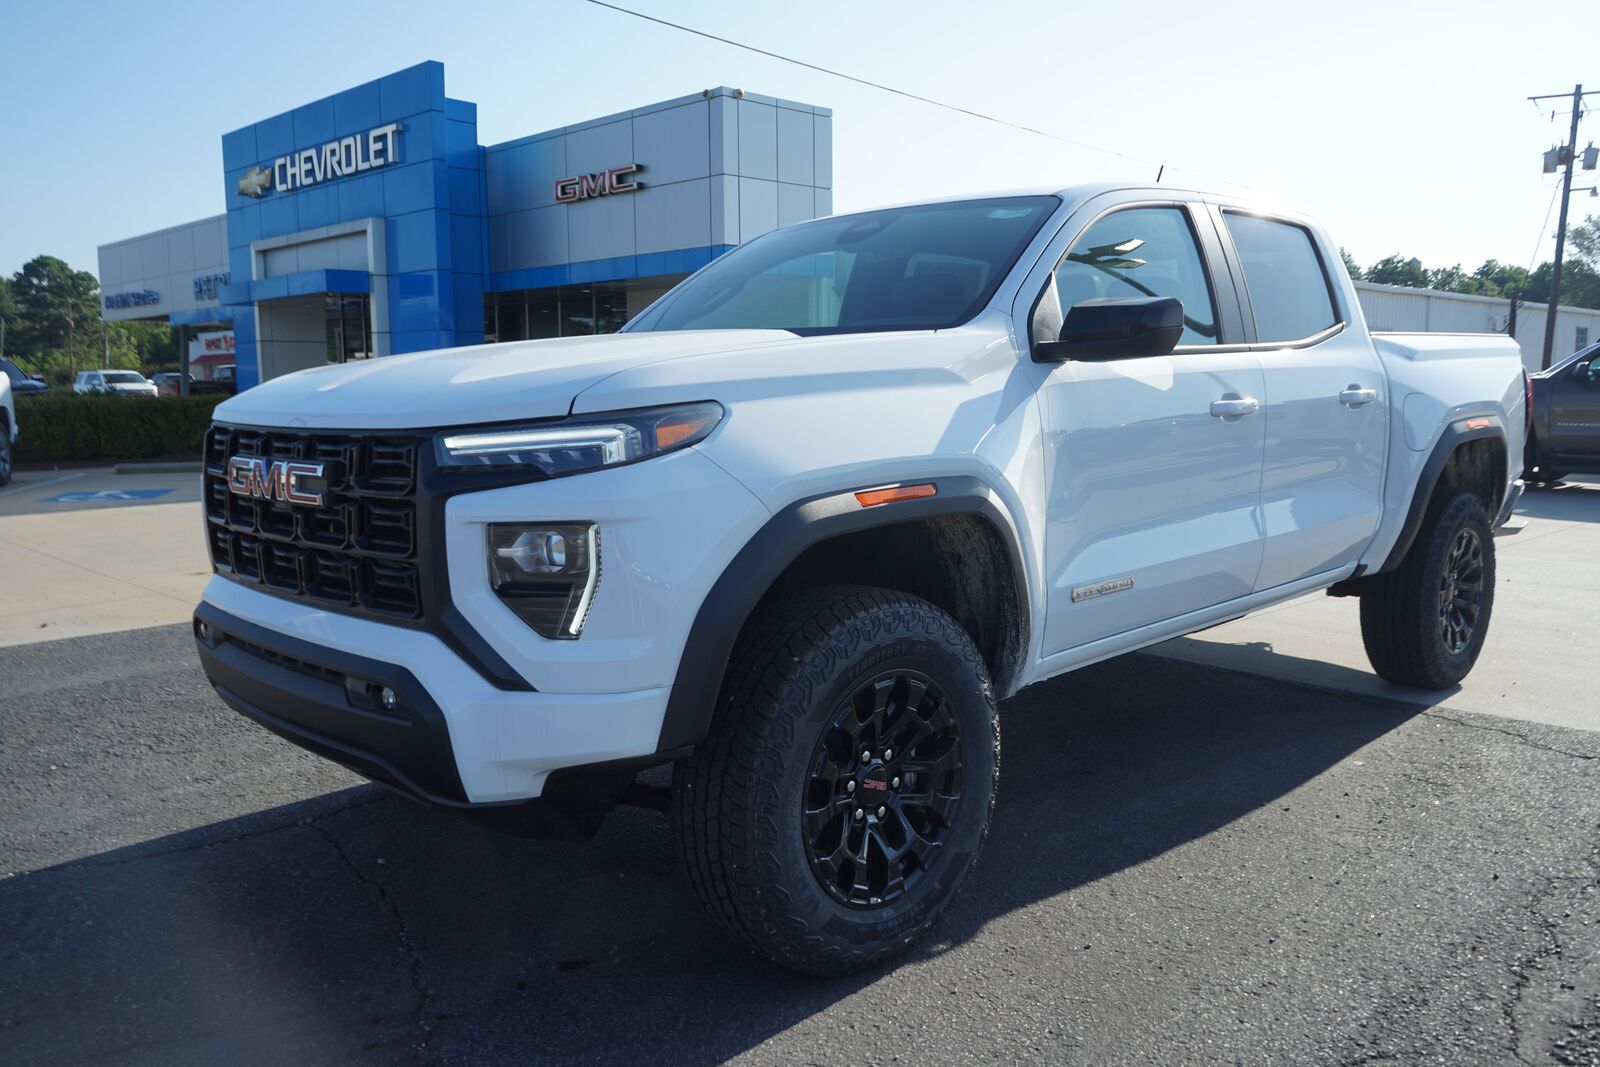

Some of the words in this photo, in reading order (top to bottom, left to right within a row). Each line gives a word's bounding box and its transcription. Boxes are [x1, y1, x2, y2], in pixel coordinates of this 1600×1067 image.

[274, 122, 399, 192] CHEVROLET
[554, 163, 640, 203] GMC
[227, 456, 324, 506] GMC
